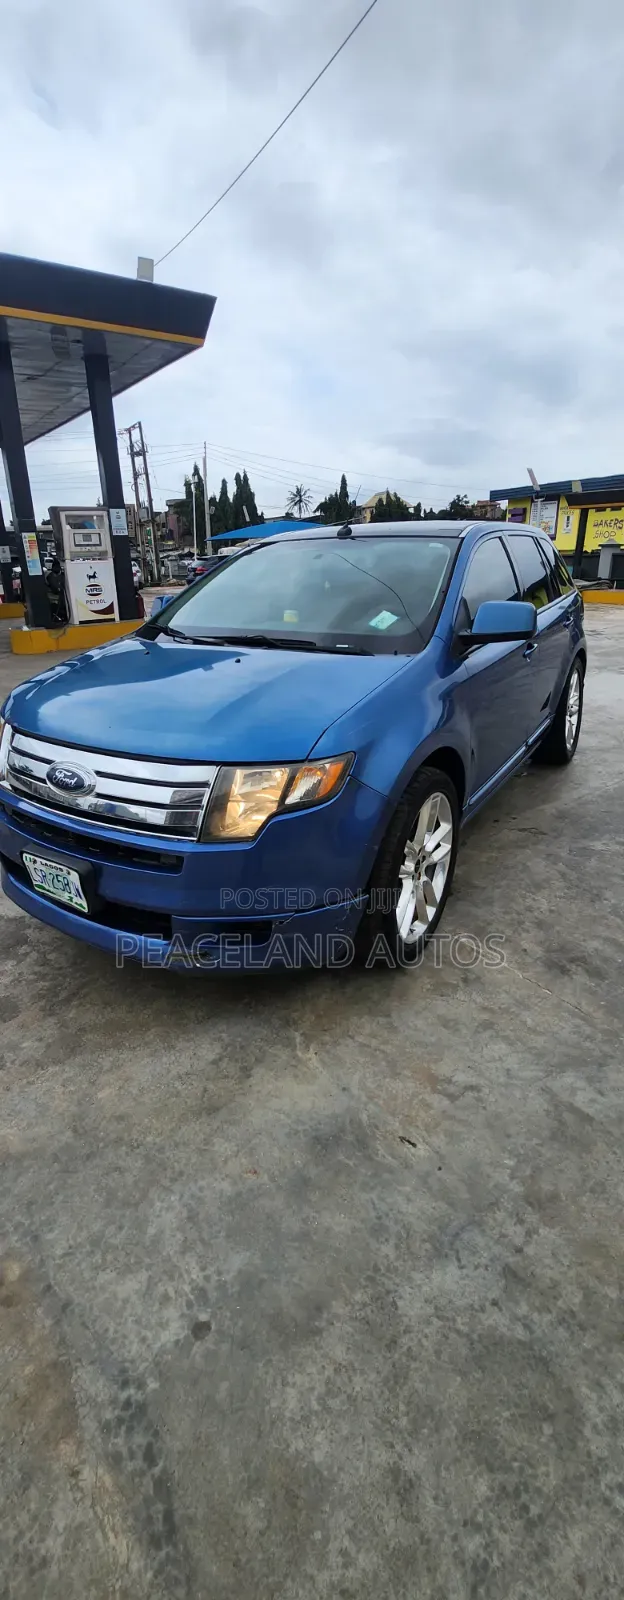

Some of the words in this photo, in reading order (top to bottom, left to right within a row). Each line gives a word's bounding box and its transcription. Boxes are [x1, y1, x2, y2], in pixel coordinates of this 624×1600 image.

[593, 530, 616, 539] SHOP
[52, 769, 78, 787] Ford
[40, 861, 64, 873] LAGOS
